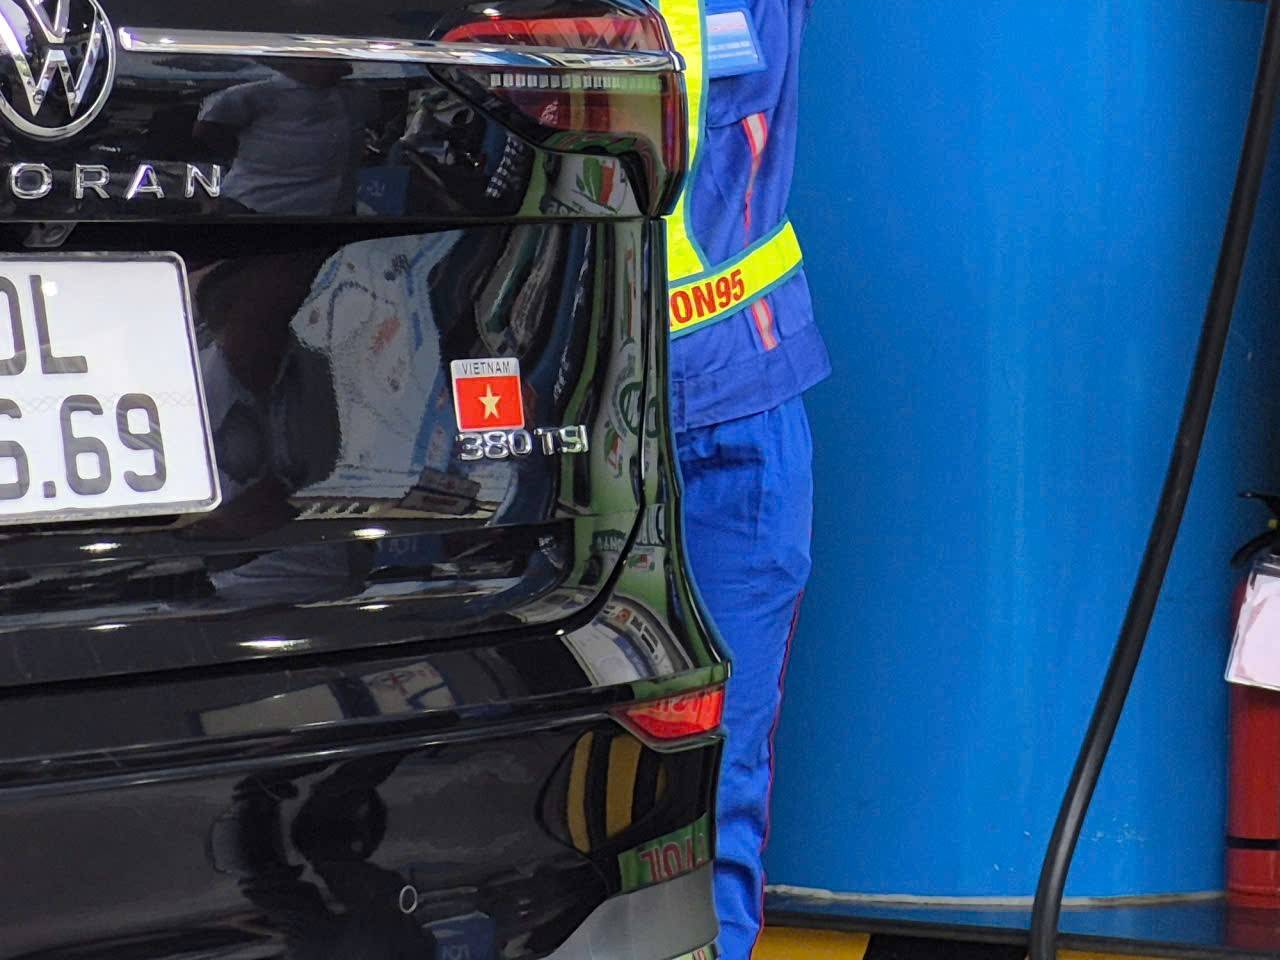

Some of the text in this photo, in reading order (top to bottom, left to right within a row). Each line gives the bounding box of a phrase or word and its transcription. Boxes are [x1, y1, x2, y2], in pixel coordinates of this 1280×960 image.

[9, 162, 221, 199] ORAN
[462, 362, 510, 375] VIETNAM
[456, 428, 533, 461] 380
